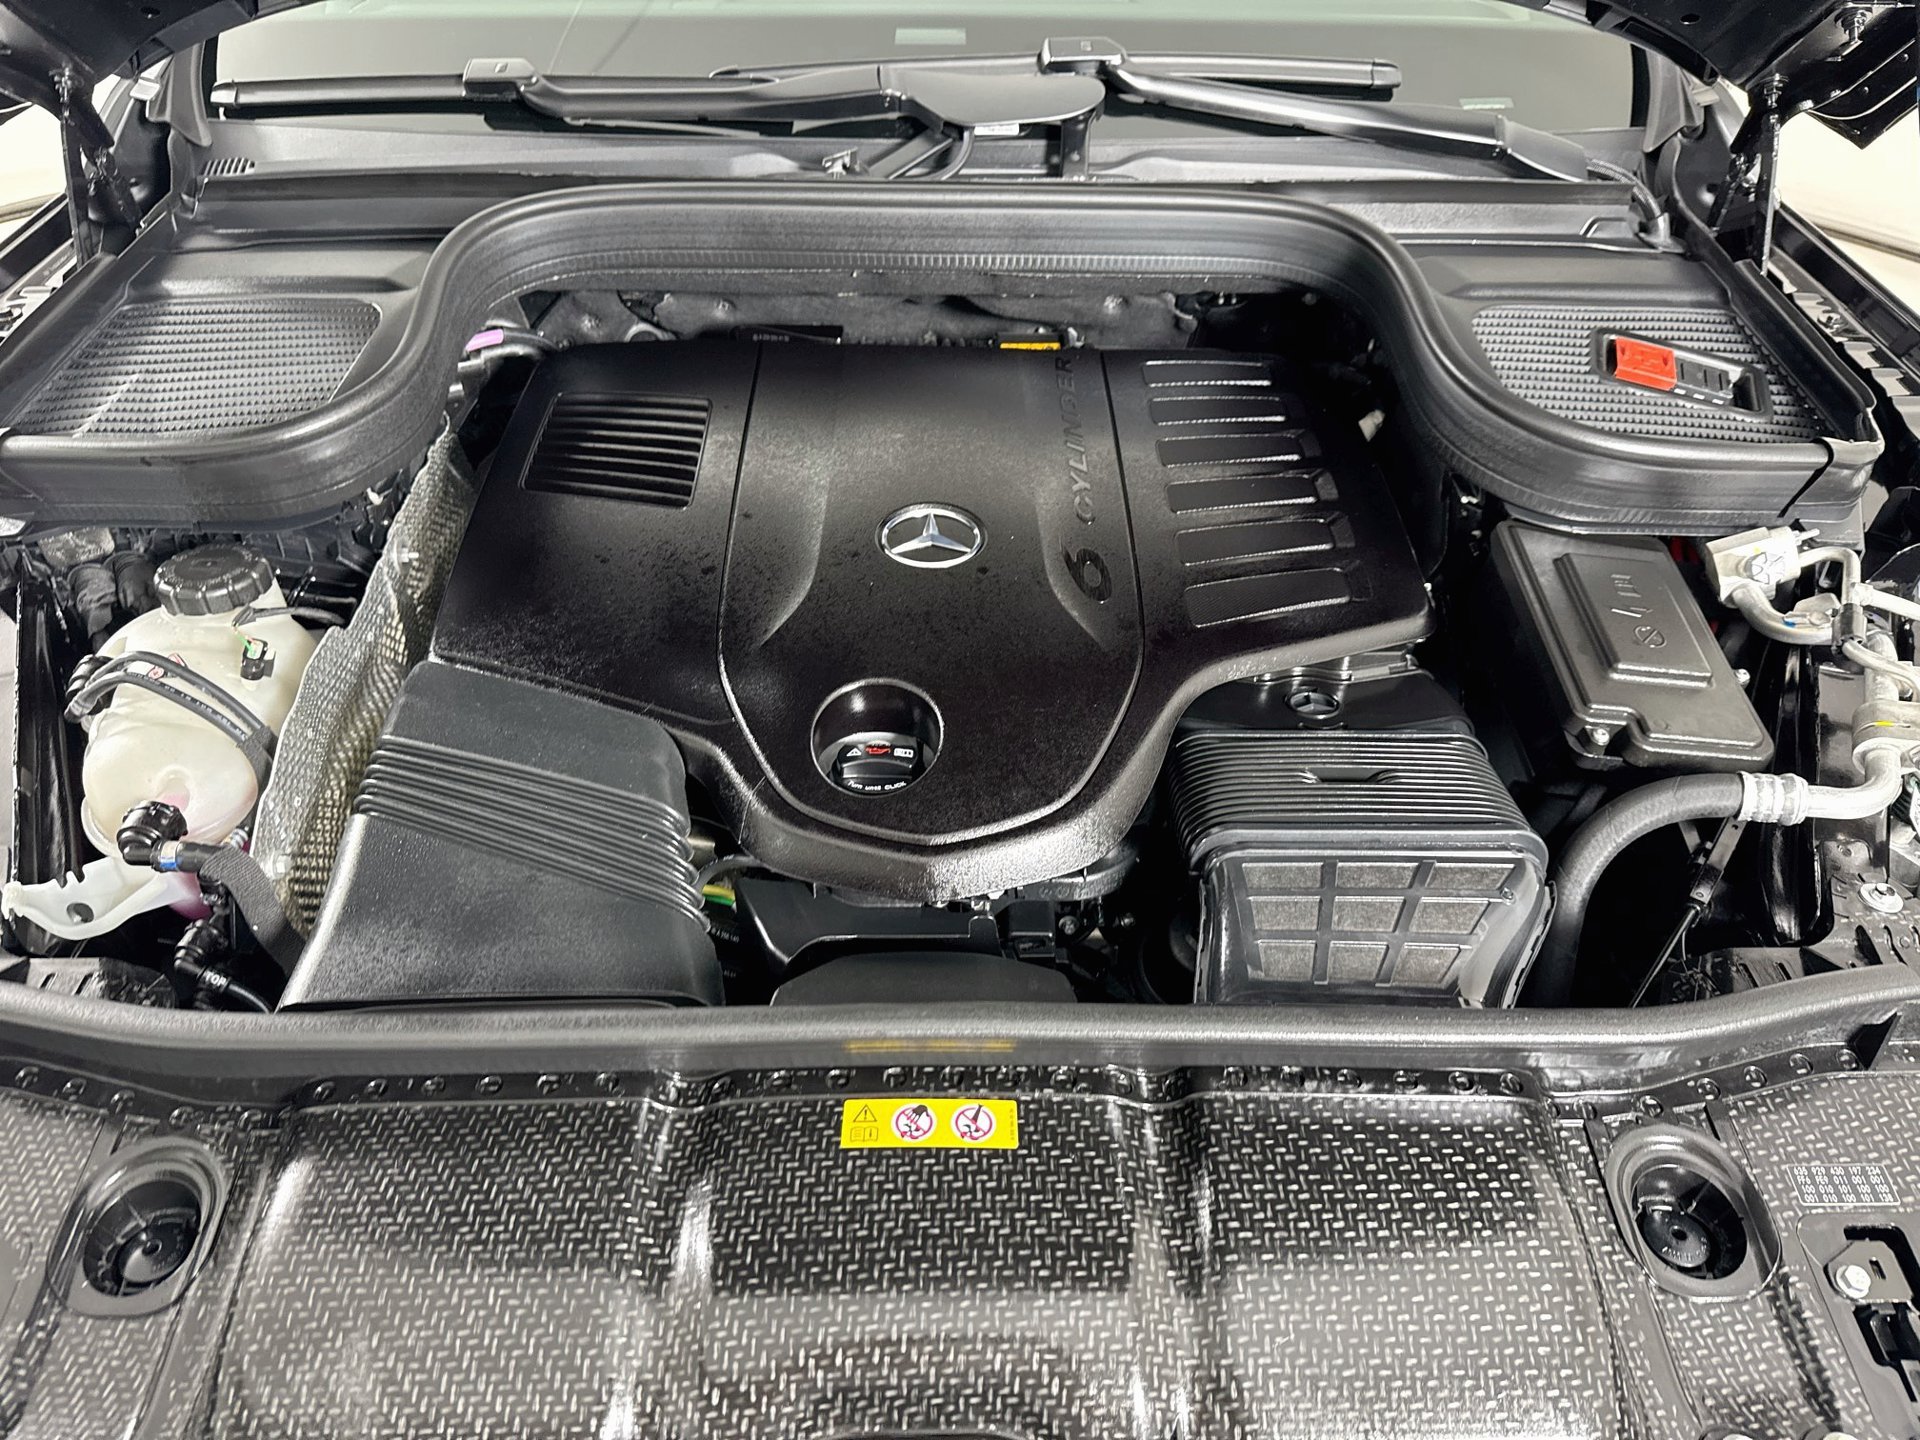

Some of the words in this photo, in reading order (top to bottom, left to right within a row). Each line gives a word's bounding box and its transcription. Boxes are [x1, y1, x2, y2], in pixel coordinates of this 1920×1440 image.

[1055, 357, 1096, 525] CYLINDER
[1061, 540, 1113, 602] 6
[884, 781, 907, 789] CLICK
[204, 970, 227, 986] TOP
[1811, 1166, 1826, 1175] 929
[1830, 1166, 1845, 1175] 430
[1848, 1166, 1861, 1175] 197
[1796, 1176, 1811, 1184] FF6
[1833, 1176, 1848, 1184] 011
[1851, 1176, 1867, 1184] 001
[1870, 1176, 1885, 1184] 001
[1801, 1185, 1816, 1193] 100
[1819, 1185, 1834, 1193] 010
[1838, 1185, 1852, 1193] 101
[1856, 1185, 1871, 1193] 100
[1875, 1185, 1890, 1193] 100
[1804, 1194, 1819, 1203] 001
[1822, 1194, 1838, 1203] 010
[1841, 1194, 1856, 1203] 100
[1860, 1194, 1875, 1203] 101
